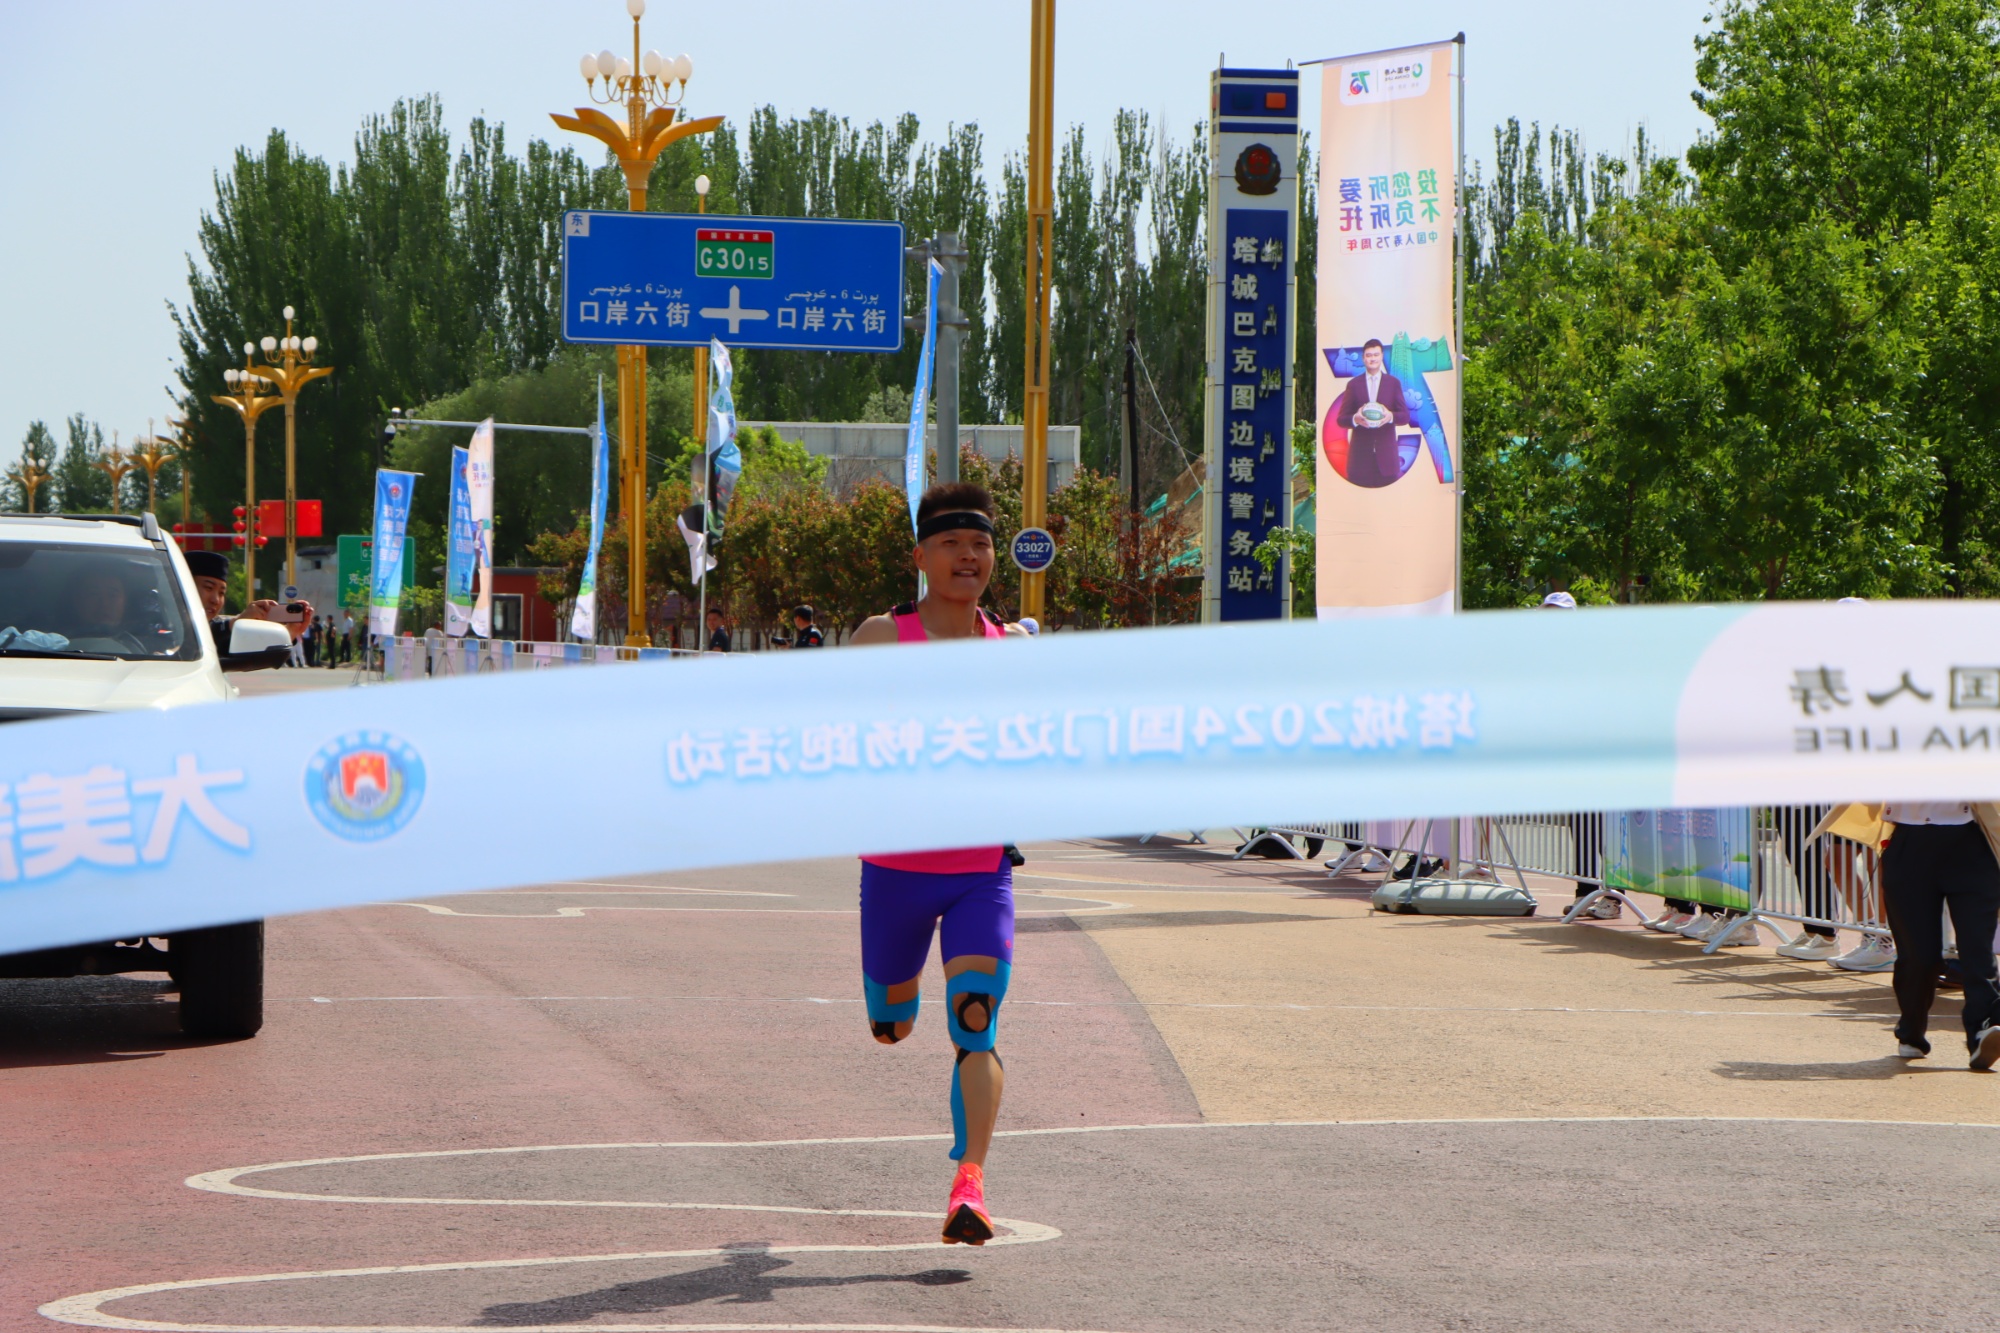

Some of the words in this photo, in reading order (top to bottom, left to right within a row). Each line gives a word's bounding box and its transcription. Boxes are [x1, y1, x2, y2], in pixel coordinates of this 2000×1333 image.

[571, 213, 583, 226] 东
[700, 247, 769, 271] G3015
[580, 300, 690, 328] 口岸六街
[777, 306, 887, 334] 口岸六街
[1228, 236, 1258, 592] 塔城巴克图边境警务站
[1016, 542, 1050, 553] 33027
